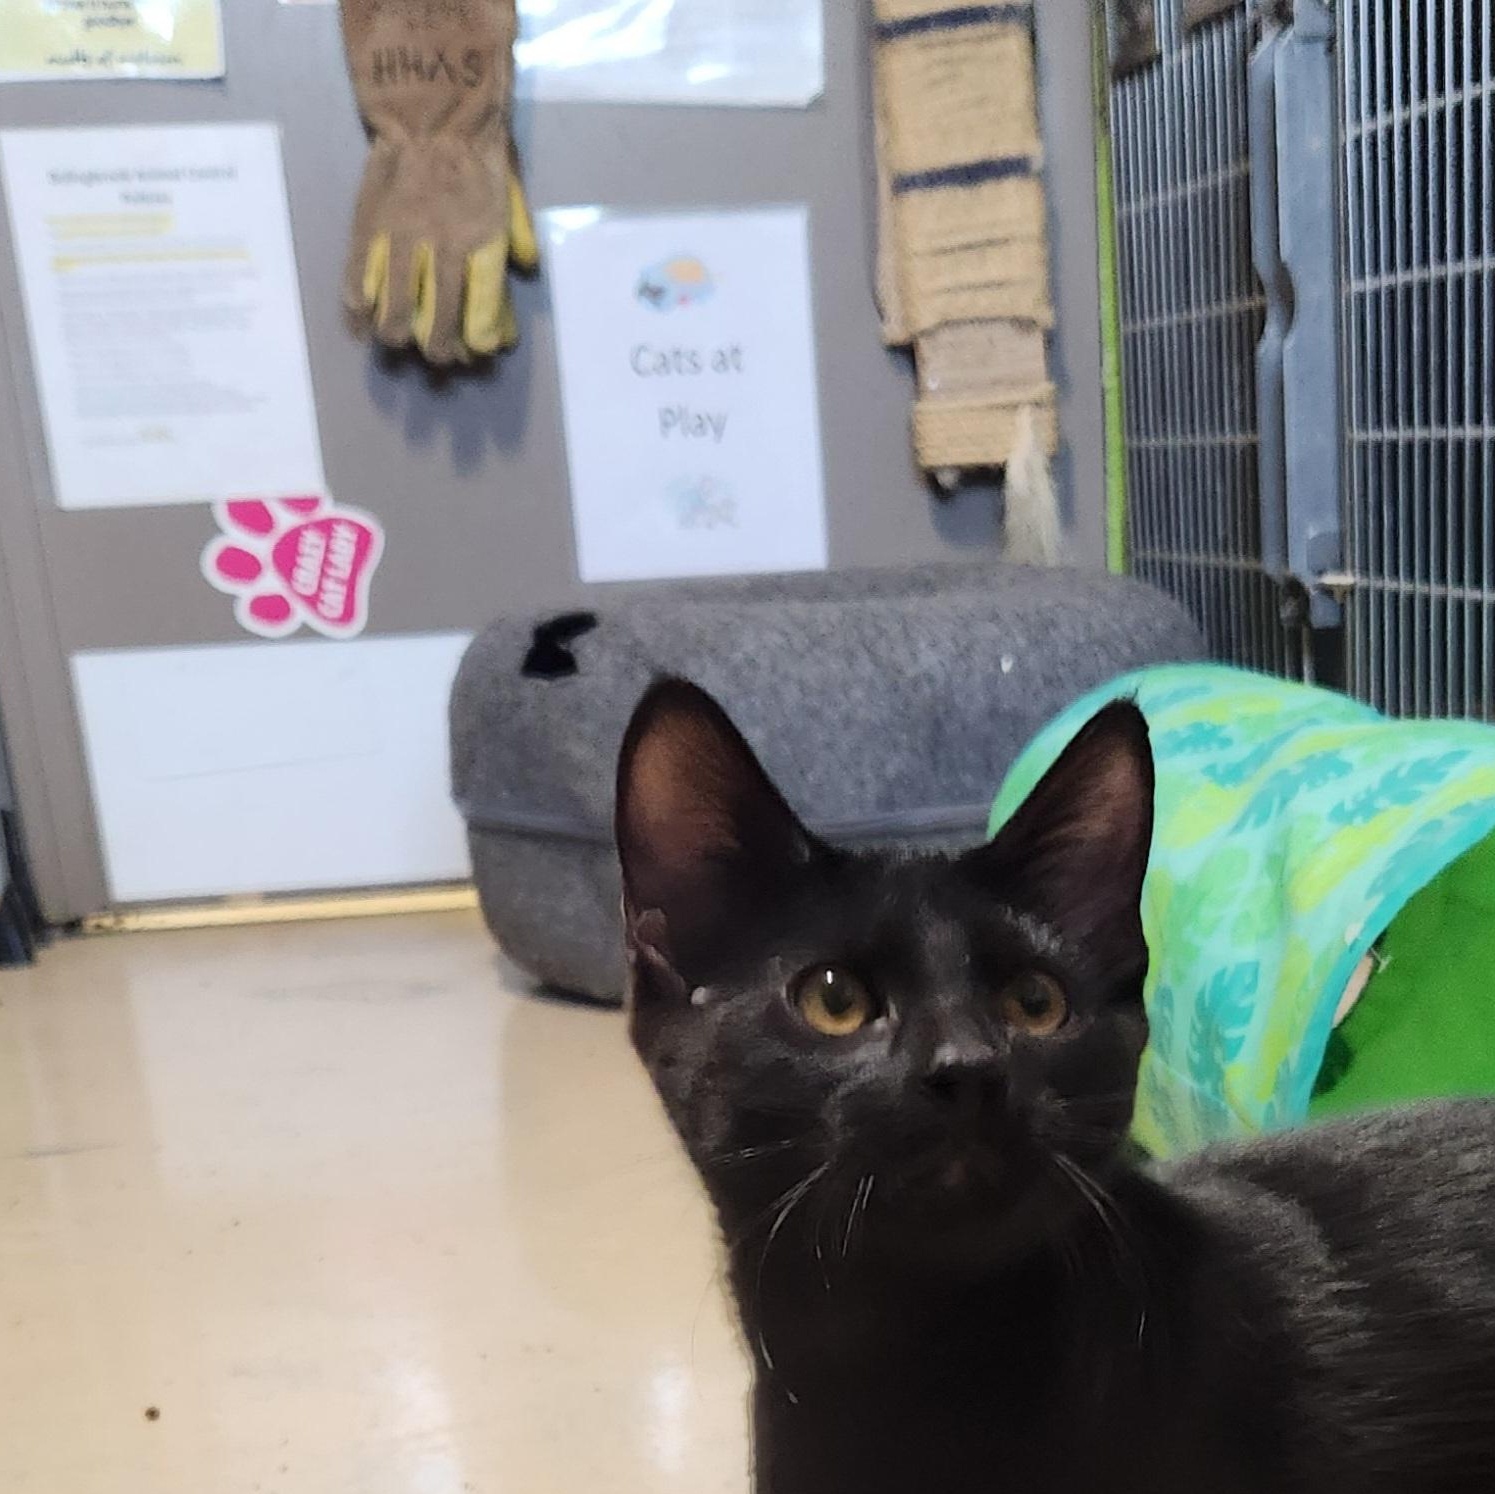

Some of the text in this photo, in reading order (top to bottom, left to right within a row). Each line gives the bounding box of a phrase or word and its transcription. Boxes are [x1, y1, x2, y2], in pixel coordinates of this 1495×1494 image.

[630, 343, 744, 378] Cats at
[659, 403, 727, 444] Play
[291, 525, 327, 597] CRAZY
[316, 522, 358, 619] CAT LADY
